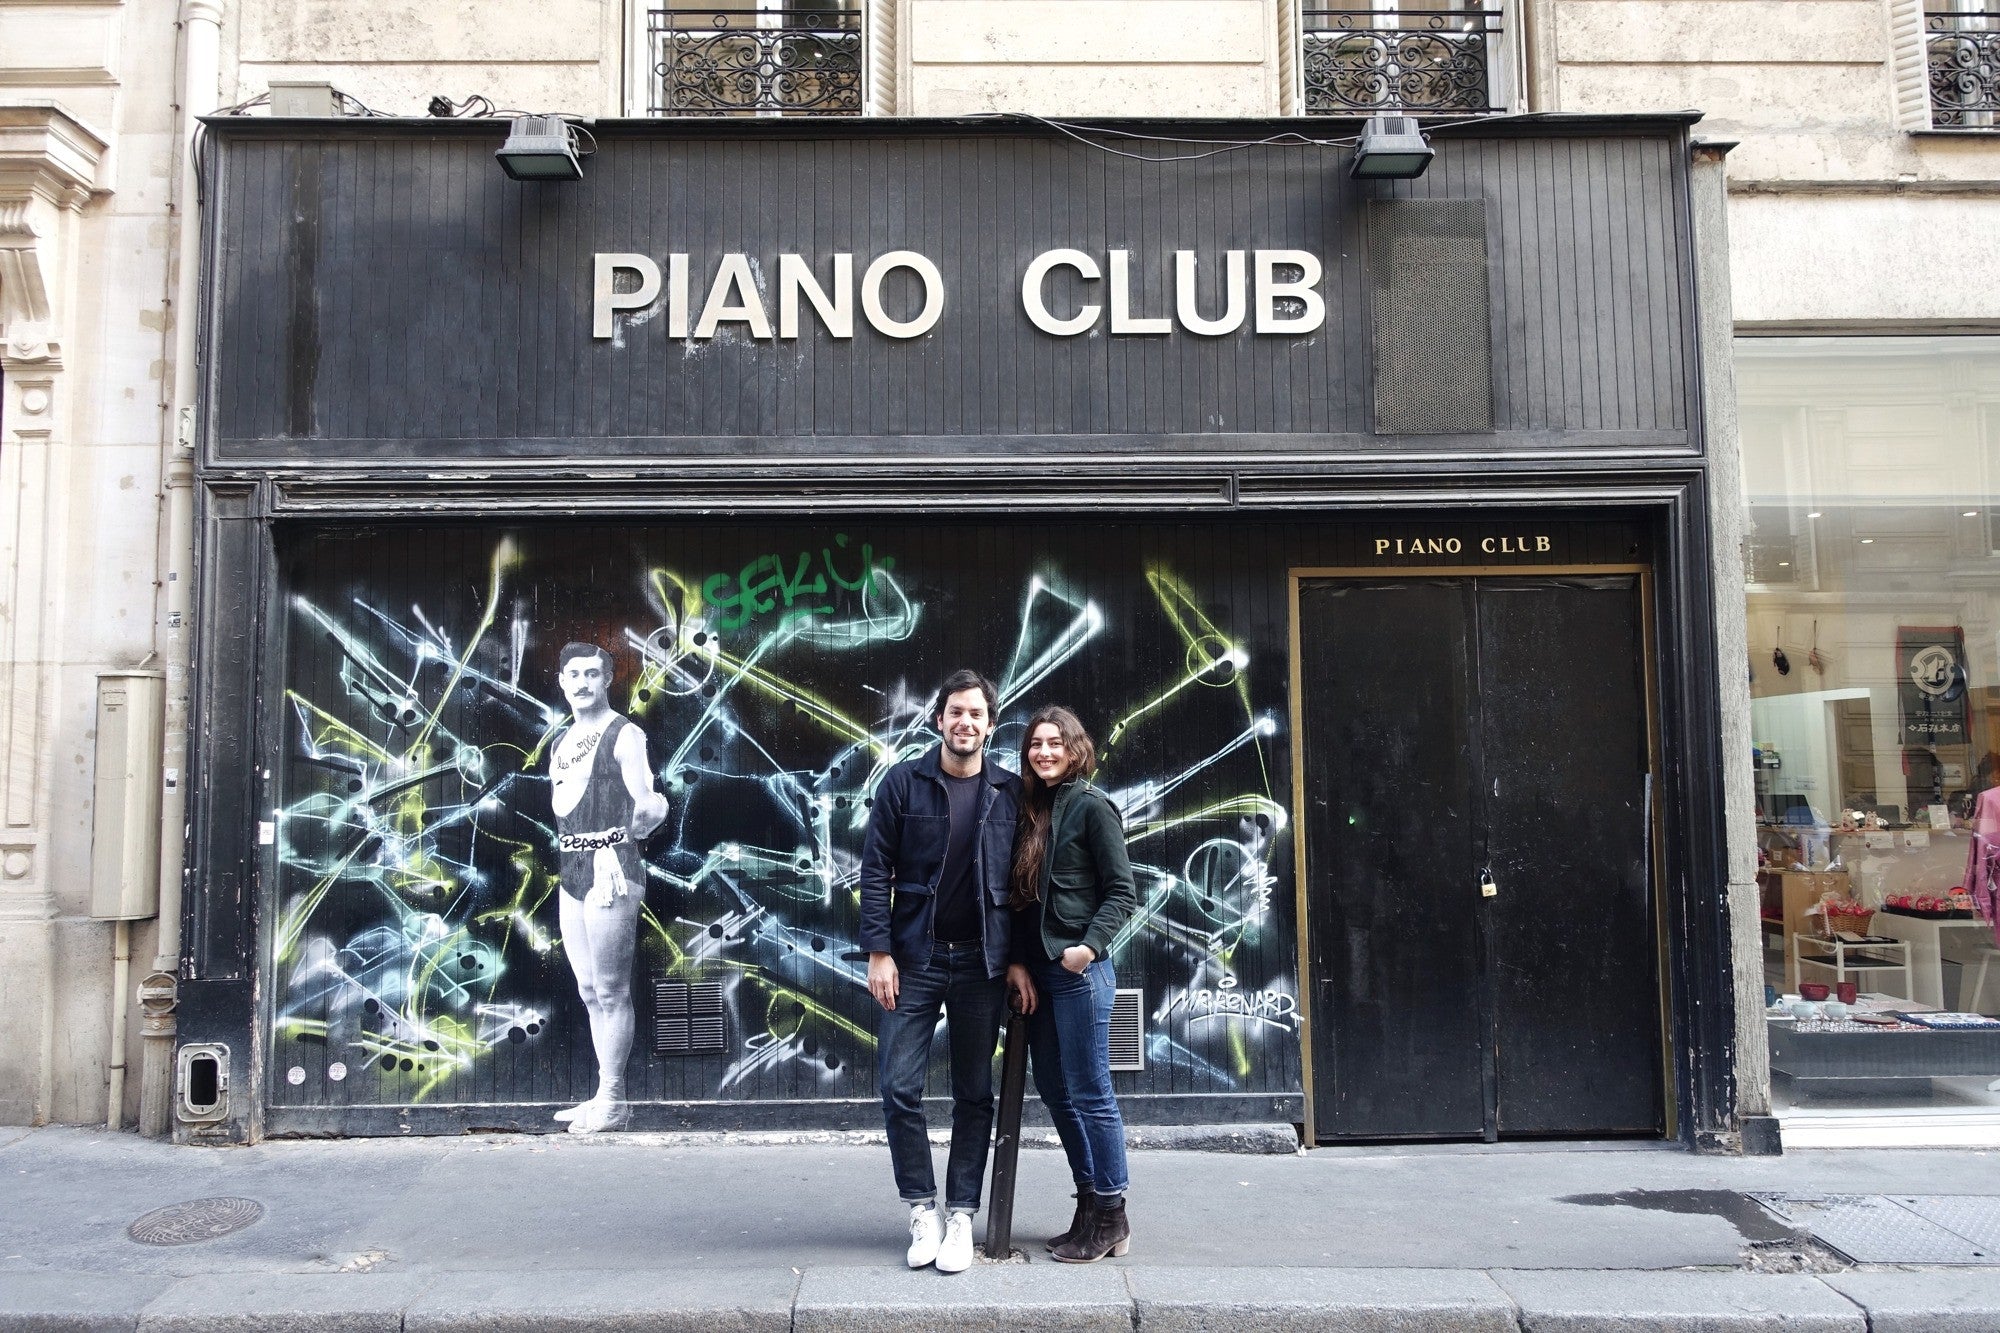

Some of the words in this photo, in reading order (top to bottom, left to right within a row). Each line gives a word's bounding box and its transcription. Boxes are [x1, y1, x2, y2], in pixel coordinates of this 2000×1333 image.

[592, 250, 944, 340] PIANO
[1021, 248, 1326, 336] CLUB
[1374, 538, 1462, 555] PIANO
[1481, 536, 1551, 554] CLUB
